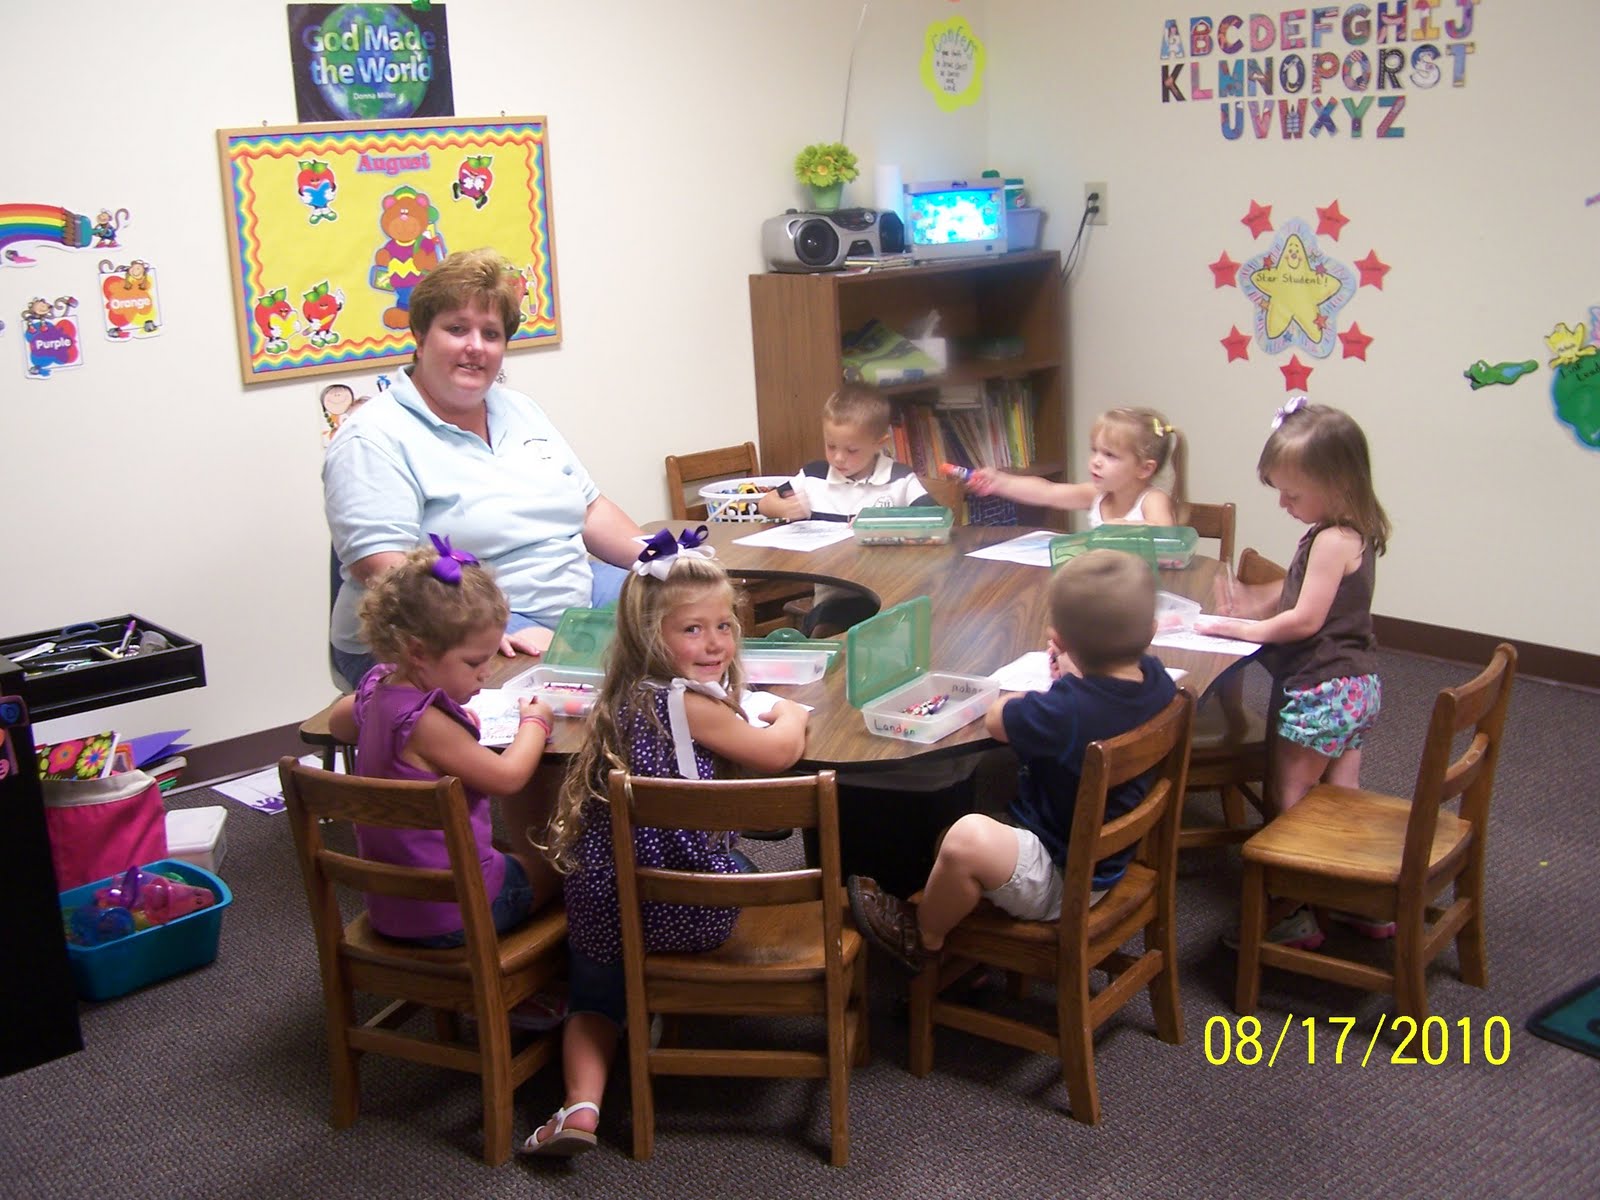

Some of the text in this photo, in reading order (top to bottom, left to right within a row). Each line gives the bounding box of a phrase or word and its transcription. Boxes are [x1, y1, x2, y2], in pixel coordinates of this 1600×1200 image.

[302, 24, 437, 52] God Made
[311, 55, 434, 85] the World
[353, 91, 377, 101] Donna
[356, 152, 431, 176] August
[1256, 273, 1277, 283] Star
[111, 297, 151, 311] Orange
[36, 336, 72, 351] Purple
